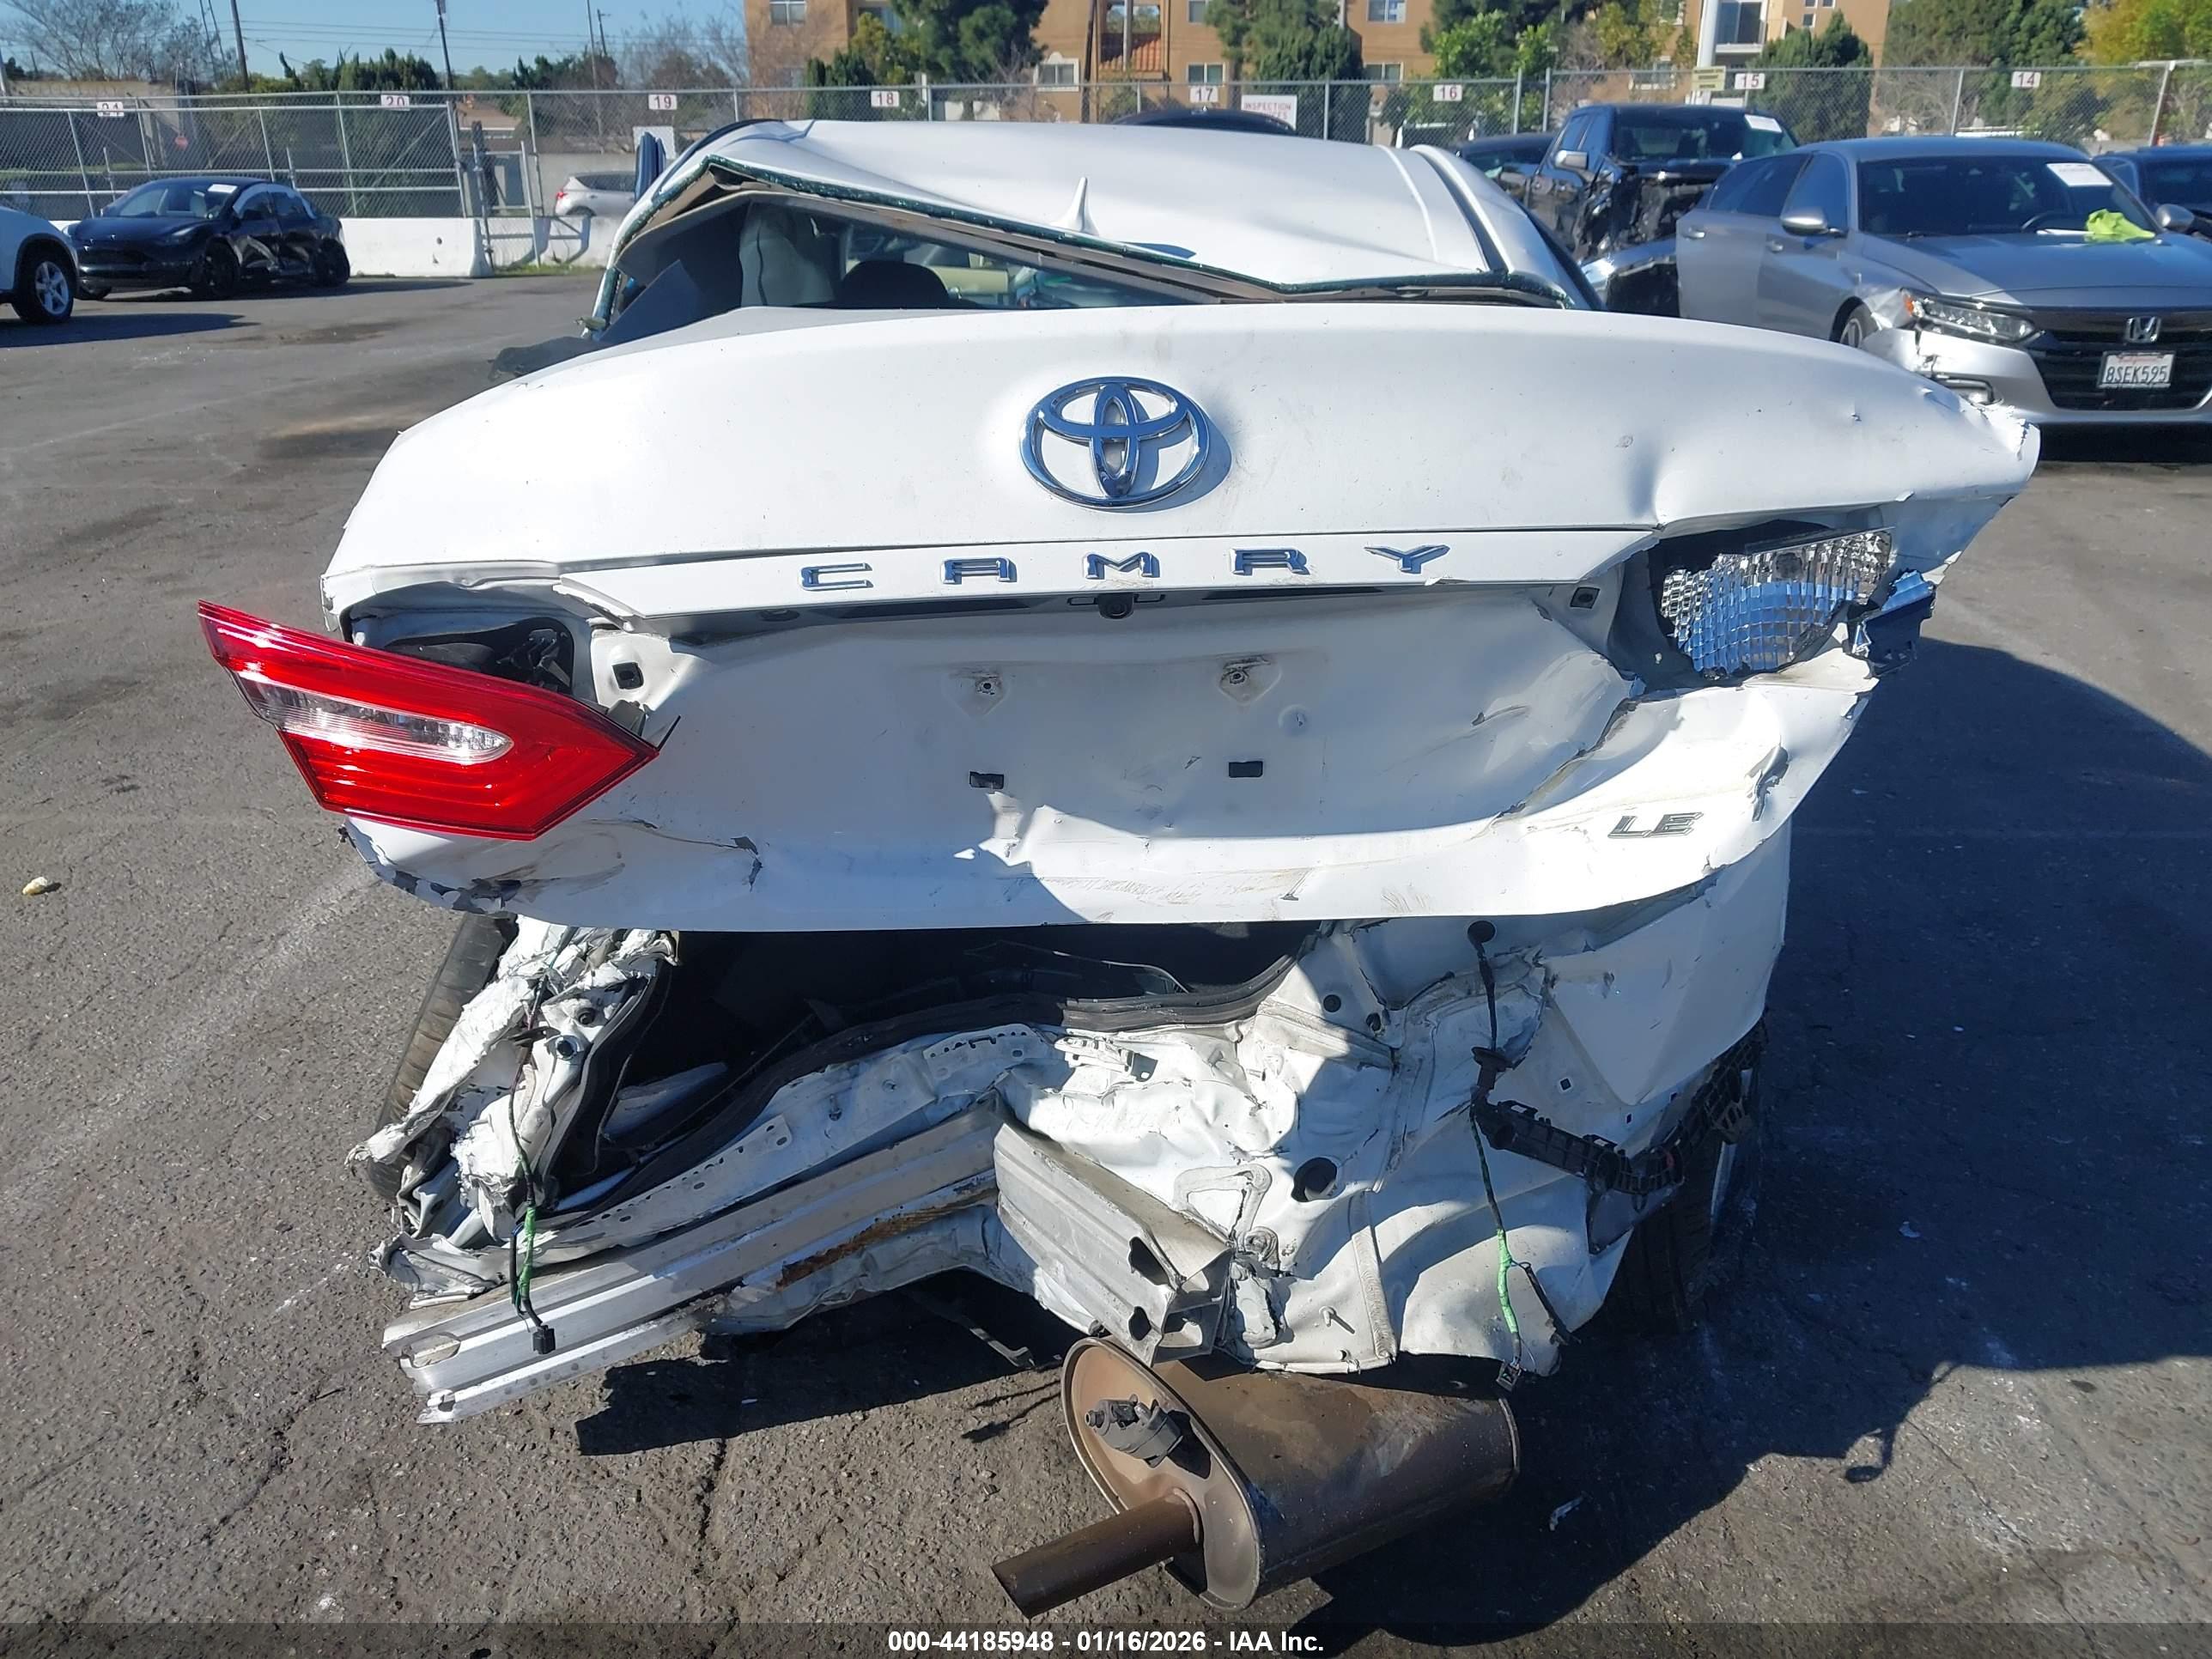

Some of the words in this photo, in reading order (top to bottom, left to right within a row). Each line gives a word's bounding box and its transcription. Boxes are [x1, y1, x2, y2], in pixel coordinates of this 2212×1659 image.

[1740, 74, 1759, 88] 15
[2018, 72, 2035, 86] 14
[877, 92, 894, 106] 18
[1196, 87, 1213, 101] 17
[1439, 87, 1457, 100] 16
[386, 95, 405, 109] 20
[653, 95, 672, 109] 19
[2106, 366, 2168, 384] 8SEK595
[800, 544, 1451, 592] CAMRY
[1607, 811, 1705, 839] LE
